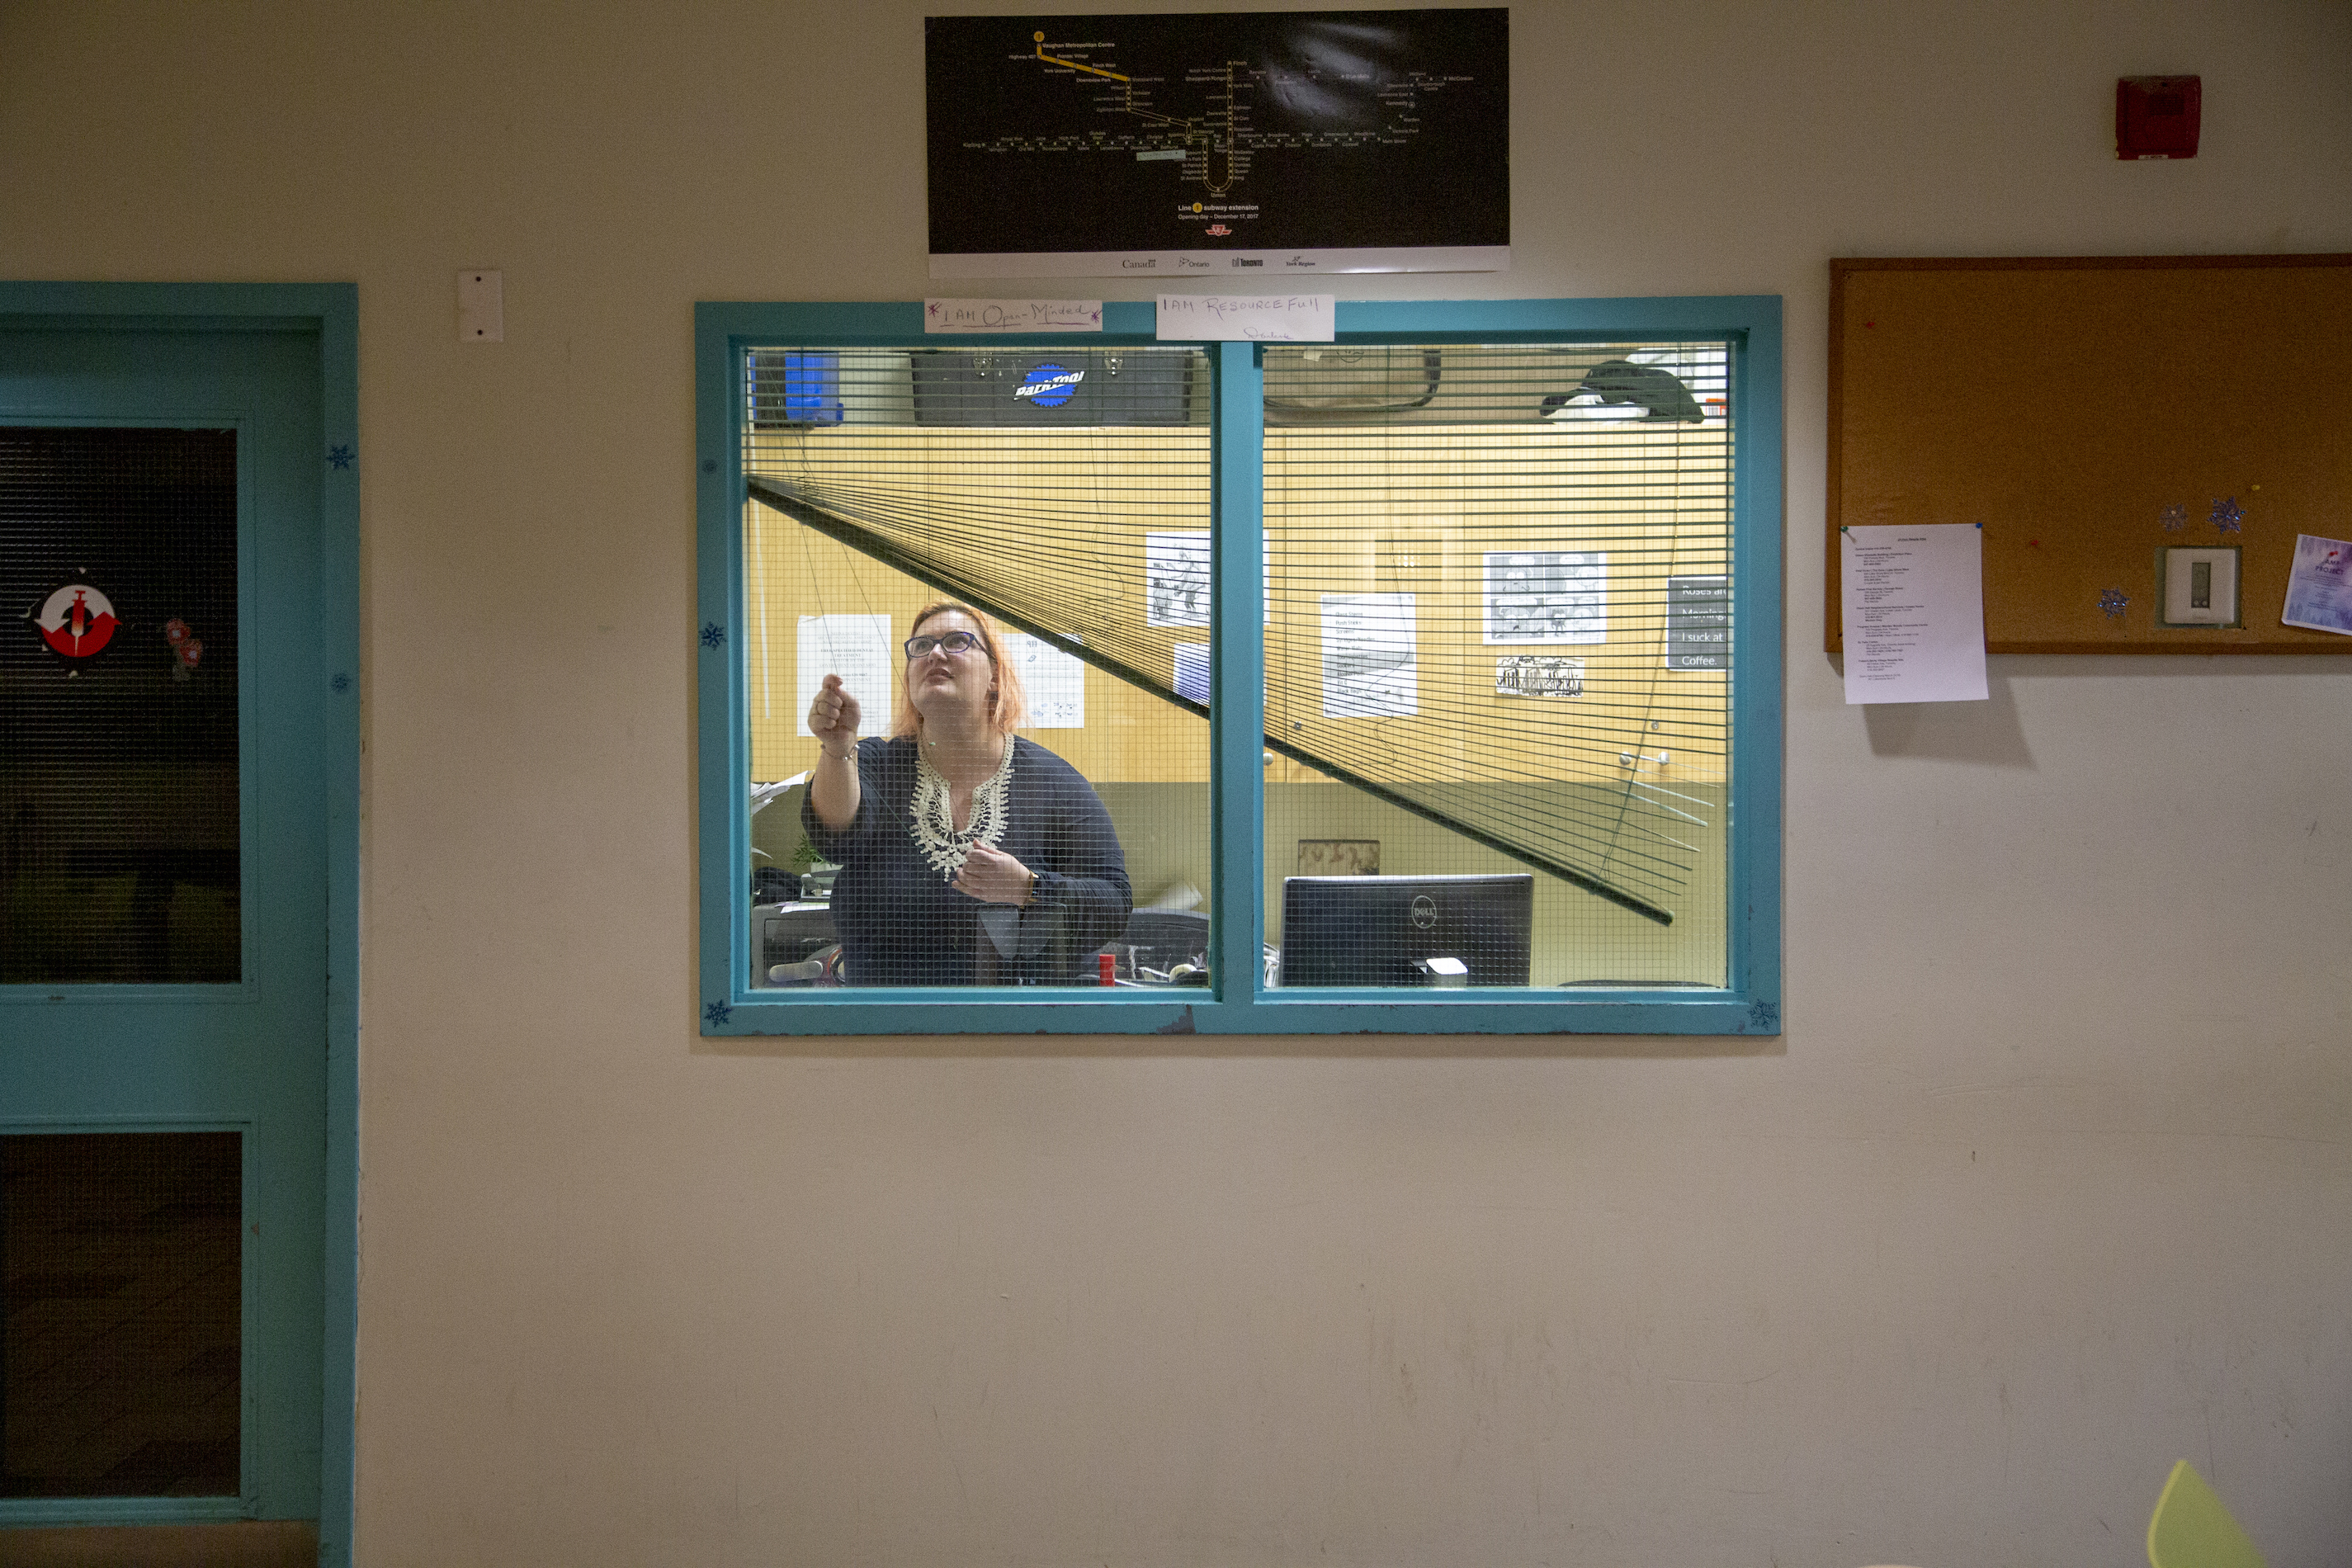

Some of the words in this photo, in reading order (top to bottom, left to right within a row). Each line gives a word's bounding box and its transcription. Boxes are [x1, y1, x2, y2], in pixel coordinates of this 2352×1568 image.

[1122, 259, 1156, 268] Canada
[1164, 298, 1167, 311] I
[1172, 300, 1194, 313] AM
[956, 309, 975, 321] AM
[2315, 565, 2344, 575] PROJECT
[1682, 585, 1712, 595] Roses
[1682, 632, 1685, 641] I
[1688, 632, 1711, 642] suck
[1713, 633, 1723, 641] at
[1682, 656, 1717, 665] Coffee.
[1414, 907, 1434, 916] DELL
